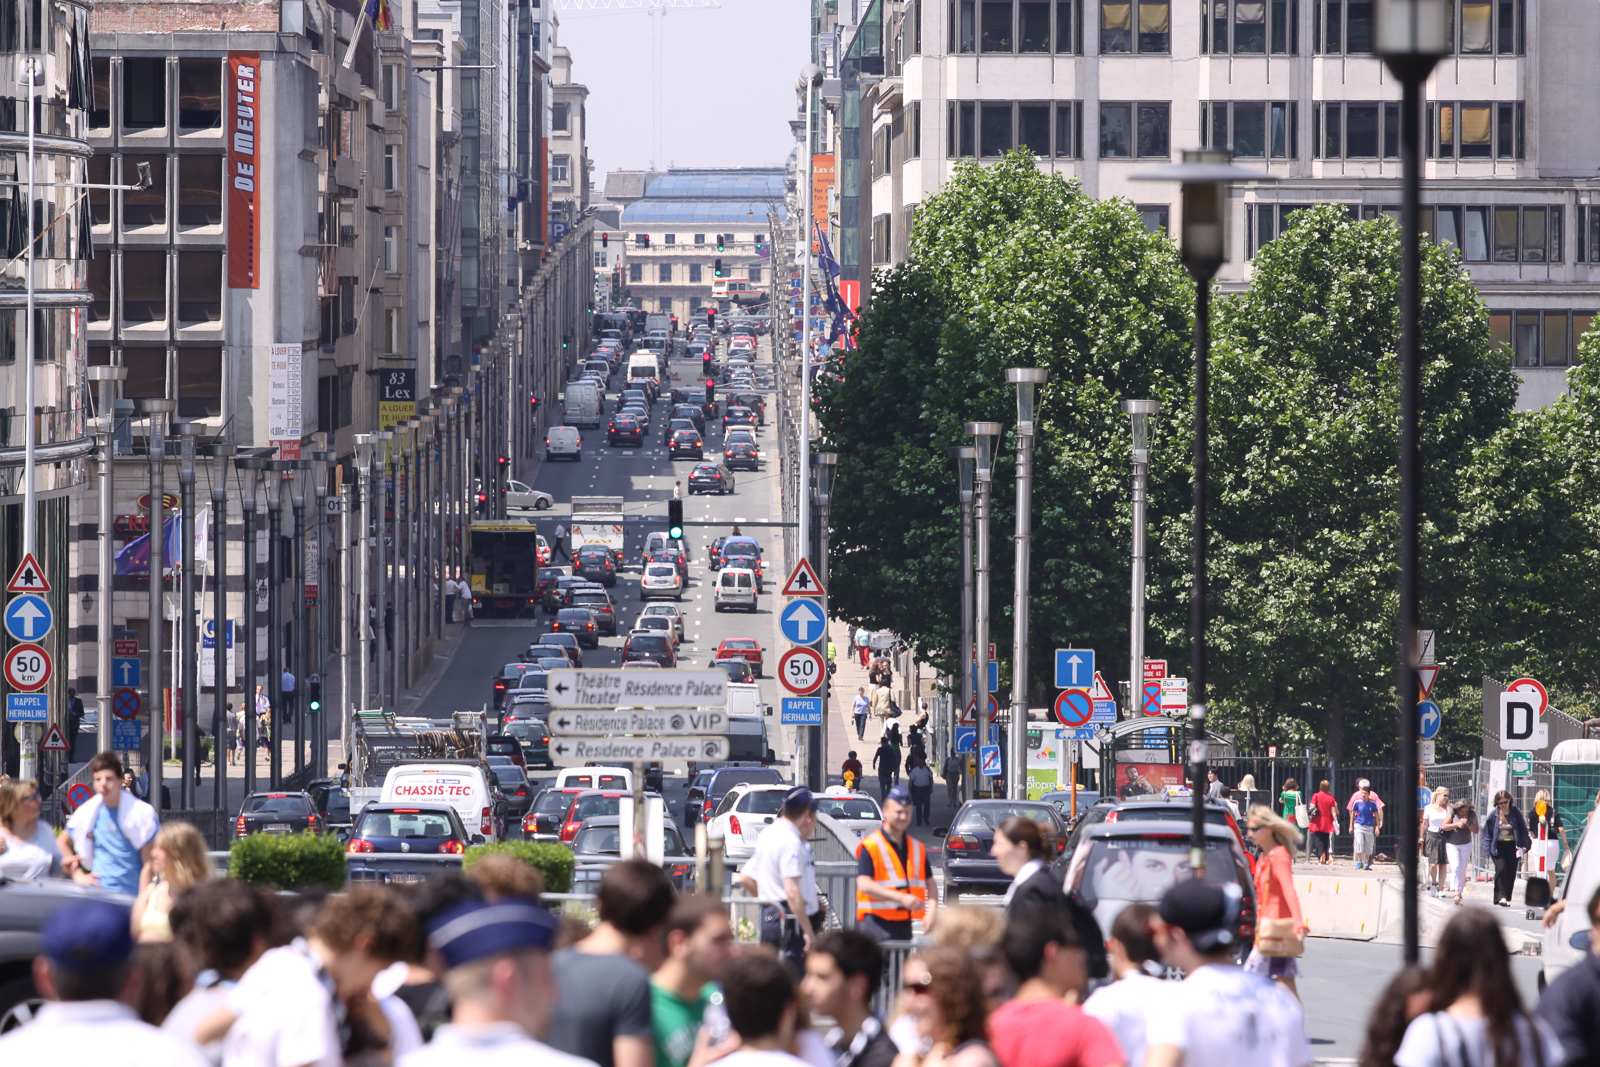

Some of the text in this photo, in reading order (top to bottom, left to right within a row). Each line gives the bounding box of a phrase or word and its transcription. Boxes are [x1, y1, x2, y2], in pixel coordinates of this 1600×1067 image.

[233, 64, 255, 193] DE MEUTER
[554, 224, 564, 237] P
[389, 372, 406, 385] 83
[384, 386, 410, 398] Lex
[17, 656, 40, 673] 50
[790, 660, 813, 676] 50
[575, 672, 621, 688] Théâtre
[625, 680, 723, 696] Résidence Palace
[14, 698, 40, 706] RAPPEL
[575, 689, 621, 704] Theater
[788, 701, 815, 709] RAPPEL
[9, 710, 46, 718] HERHALING
[783, 713, 820, 721] HERHALING
[1507, 702, 1533, 739] D
[631, 714, 665, 730] Palace
[689, 714, 721, 729] VIP
[576, 742, 696, 758] Residence Palace
[395, 785, 471, 796] CHASSIS-TEC
